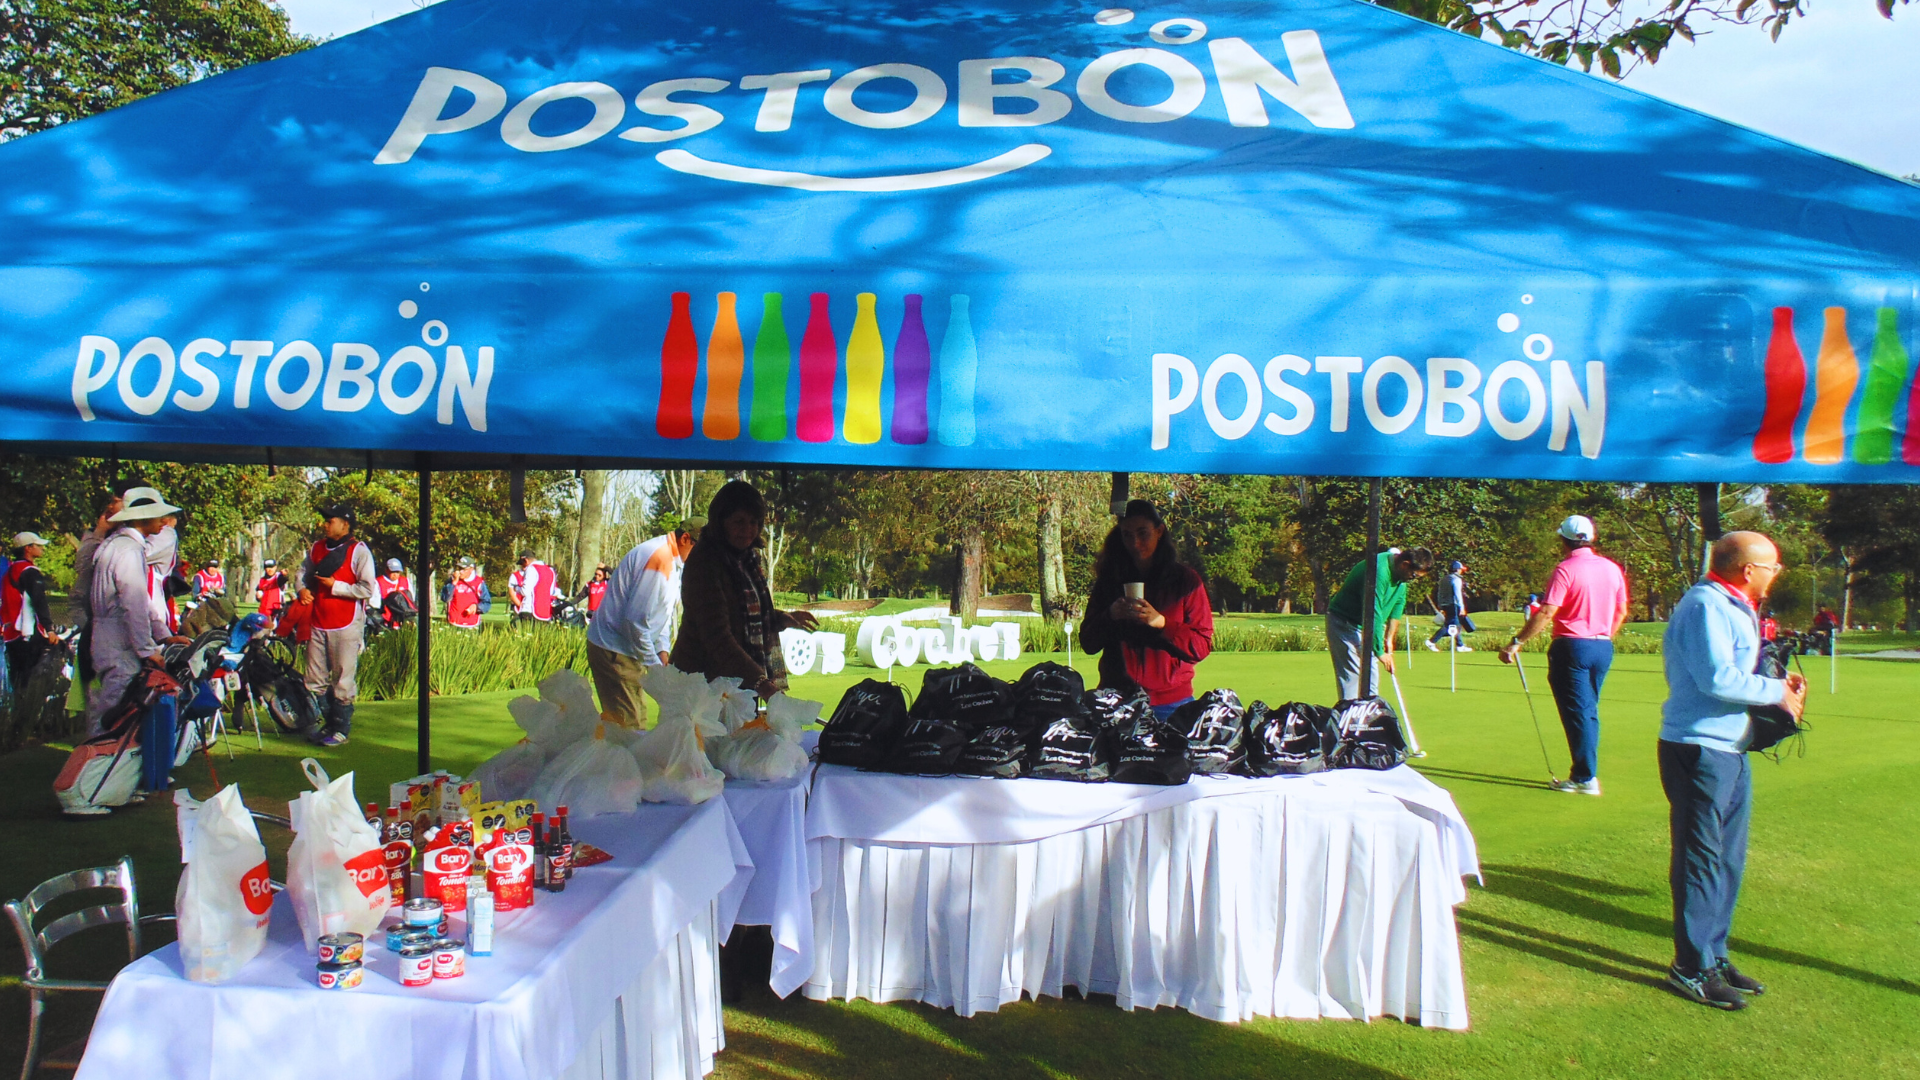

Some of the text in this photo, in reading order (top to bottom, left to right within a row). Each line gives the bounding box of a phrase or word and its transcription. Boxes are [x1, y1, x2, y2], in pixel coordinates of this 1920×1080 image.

[779, 614, 1021, 676] os Coches
[441, 854, 467, 866] Bary
[497, 853, 522, 865] Bary
[496, 874, 527, 886] Tomate
